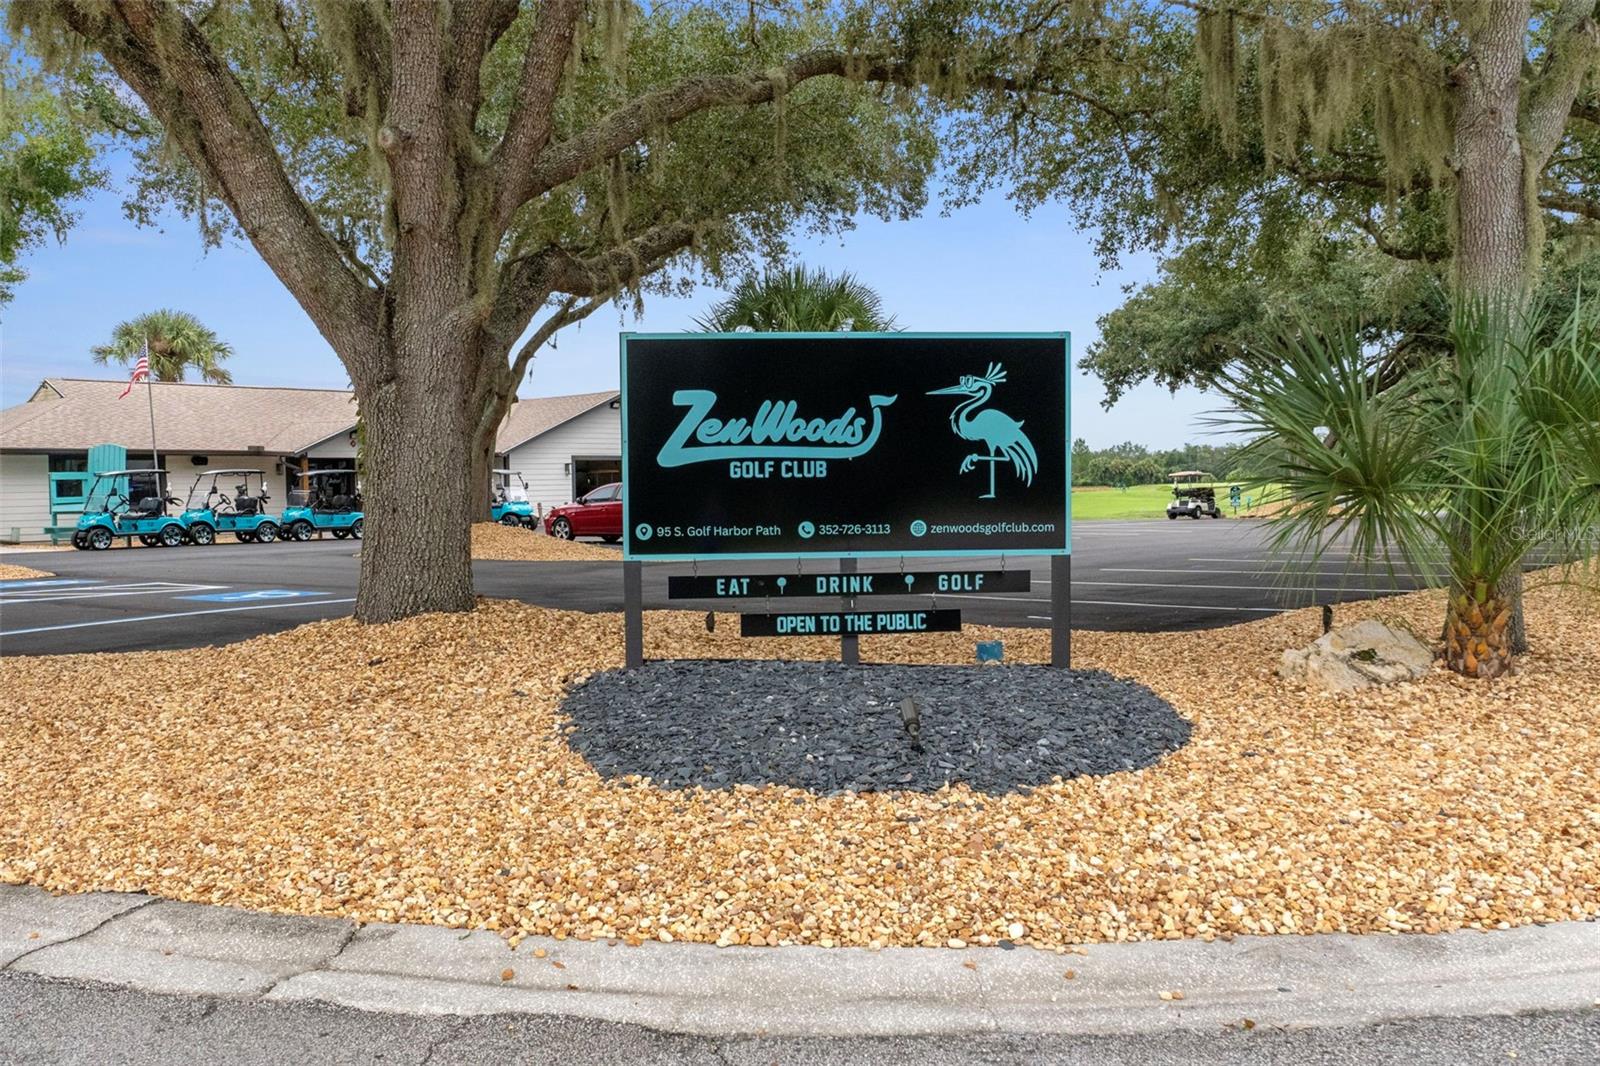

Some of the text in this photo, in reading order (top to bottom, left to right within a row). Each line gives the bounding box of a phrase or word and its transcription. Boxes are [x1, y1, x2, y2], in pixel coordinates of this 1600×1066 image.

[729, 460, 827, 478] GOLF CLUB
[656, 525, 781, 537] 95 S. Golf Harbor Path
[818, 523, 891, 535] 352-726-3113
[930, 521, 1055, 536] zenwoodsgolfclub.com
[716, 574, 984, 595] EAT DRINK GOLF
[776, 613, 927, 633] OPEN TO THE PUBLIC
